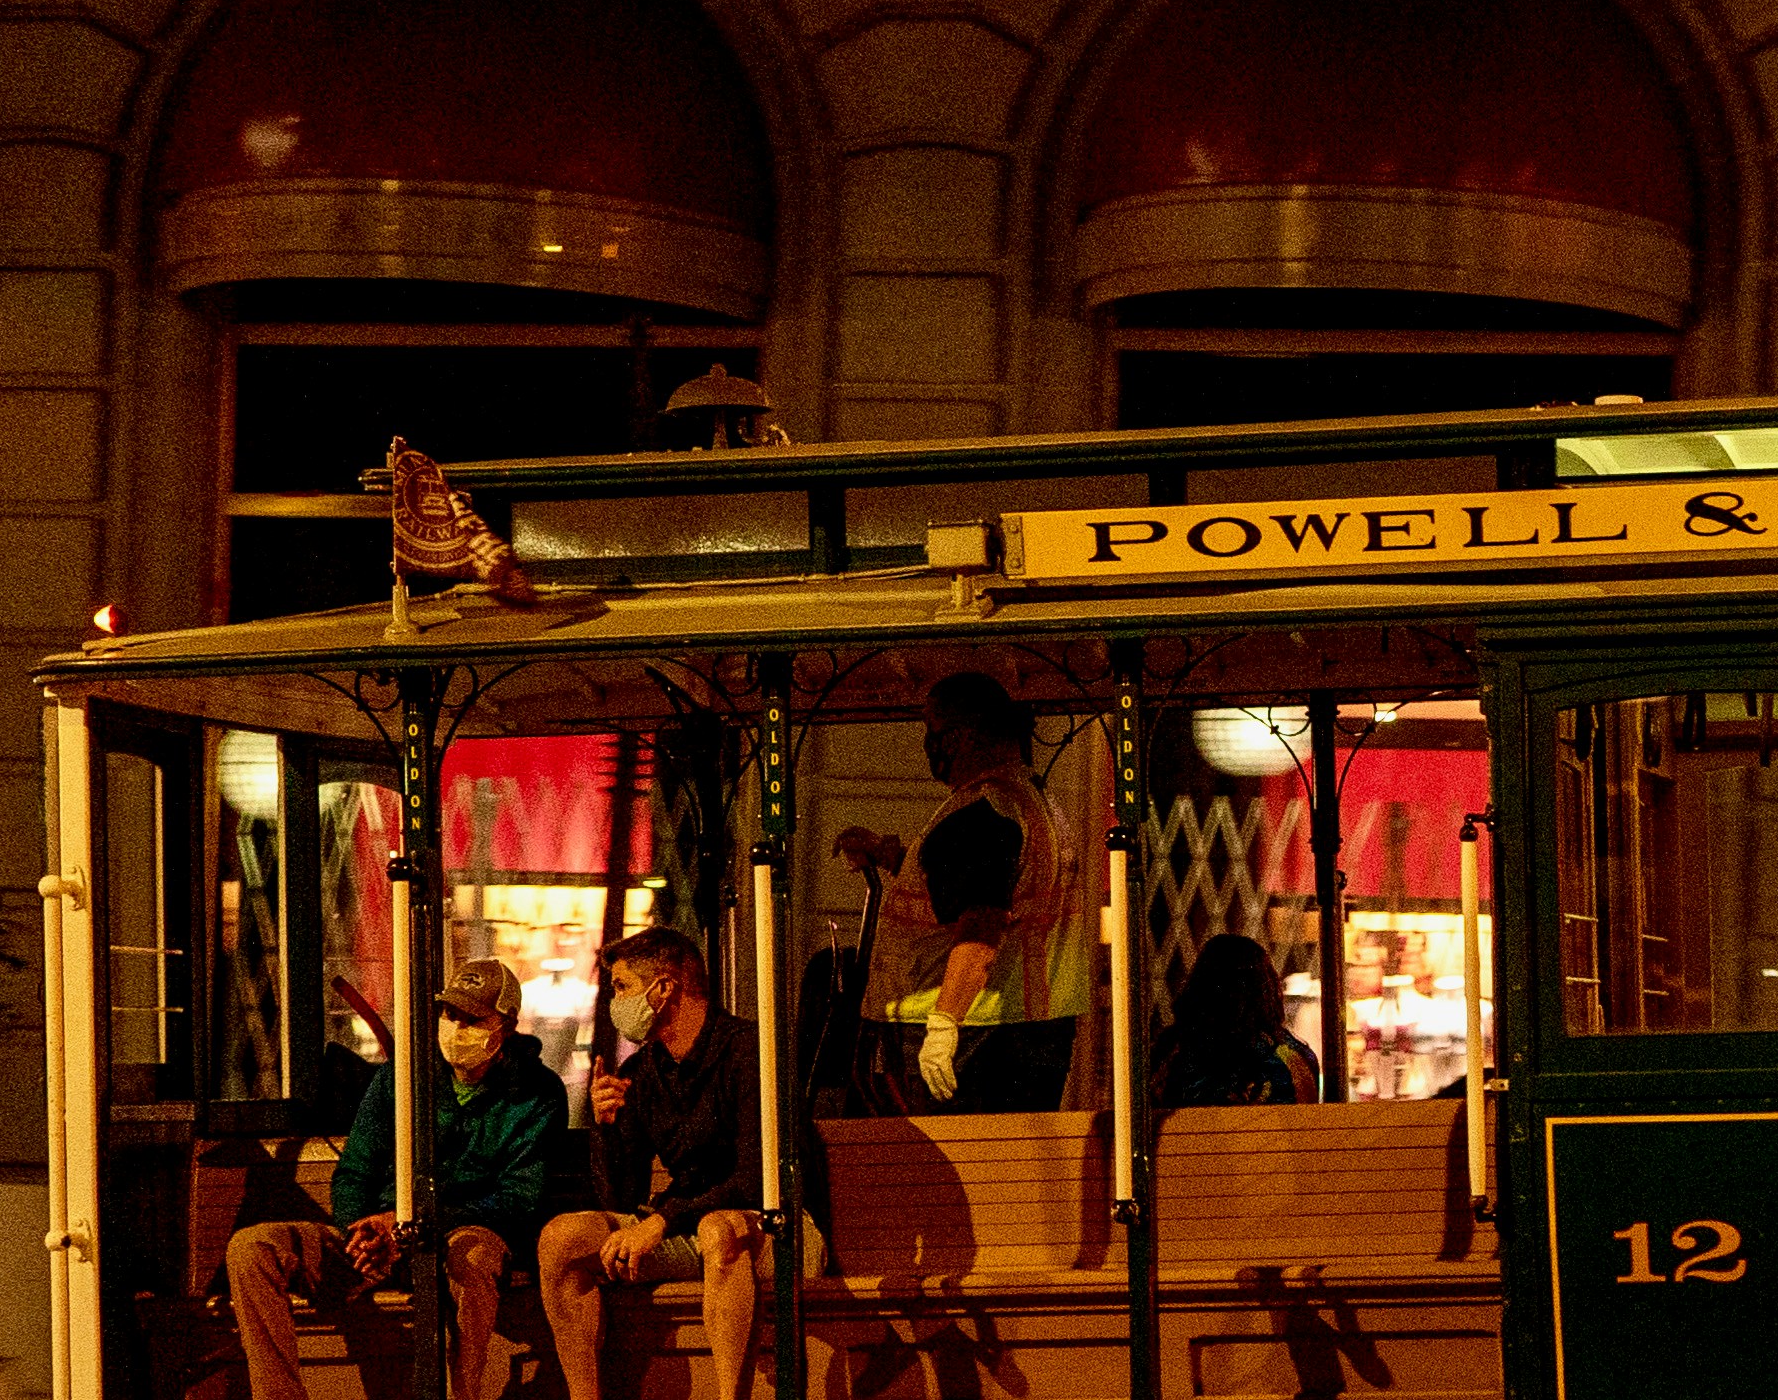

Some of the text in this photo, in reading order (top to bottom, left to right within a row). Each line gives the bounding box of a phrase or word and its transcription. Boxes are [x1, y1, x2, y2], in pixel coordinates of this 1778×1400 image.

[1086, 501, 1628, 563] POWELL
[1683, 491, 1768, 538] &
[768, 686, 781, 817] OLD ON
[1121, 673, 1135, 804] OLD ON
[410, 794, 421, 831] ON
[1613, 1219, 1748, 1284] 12
